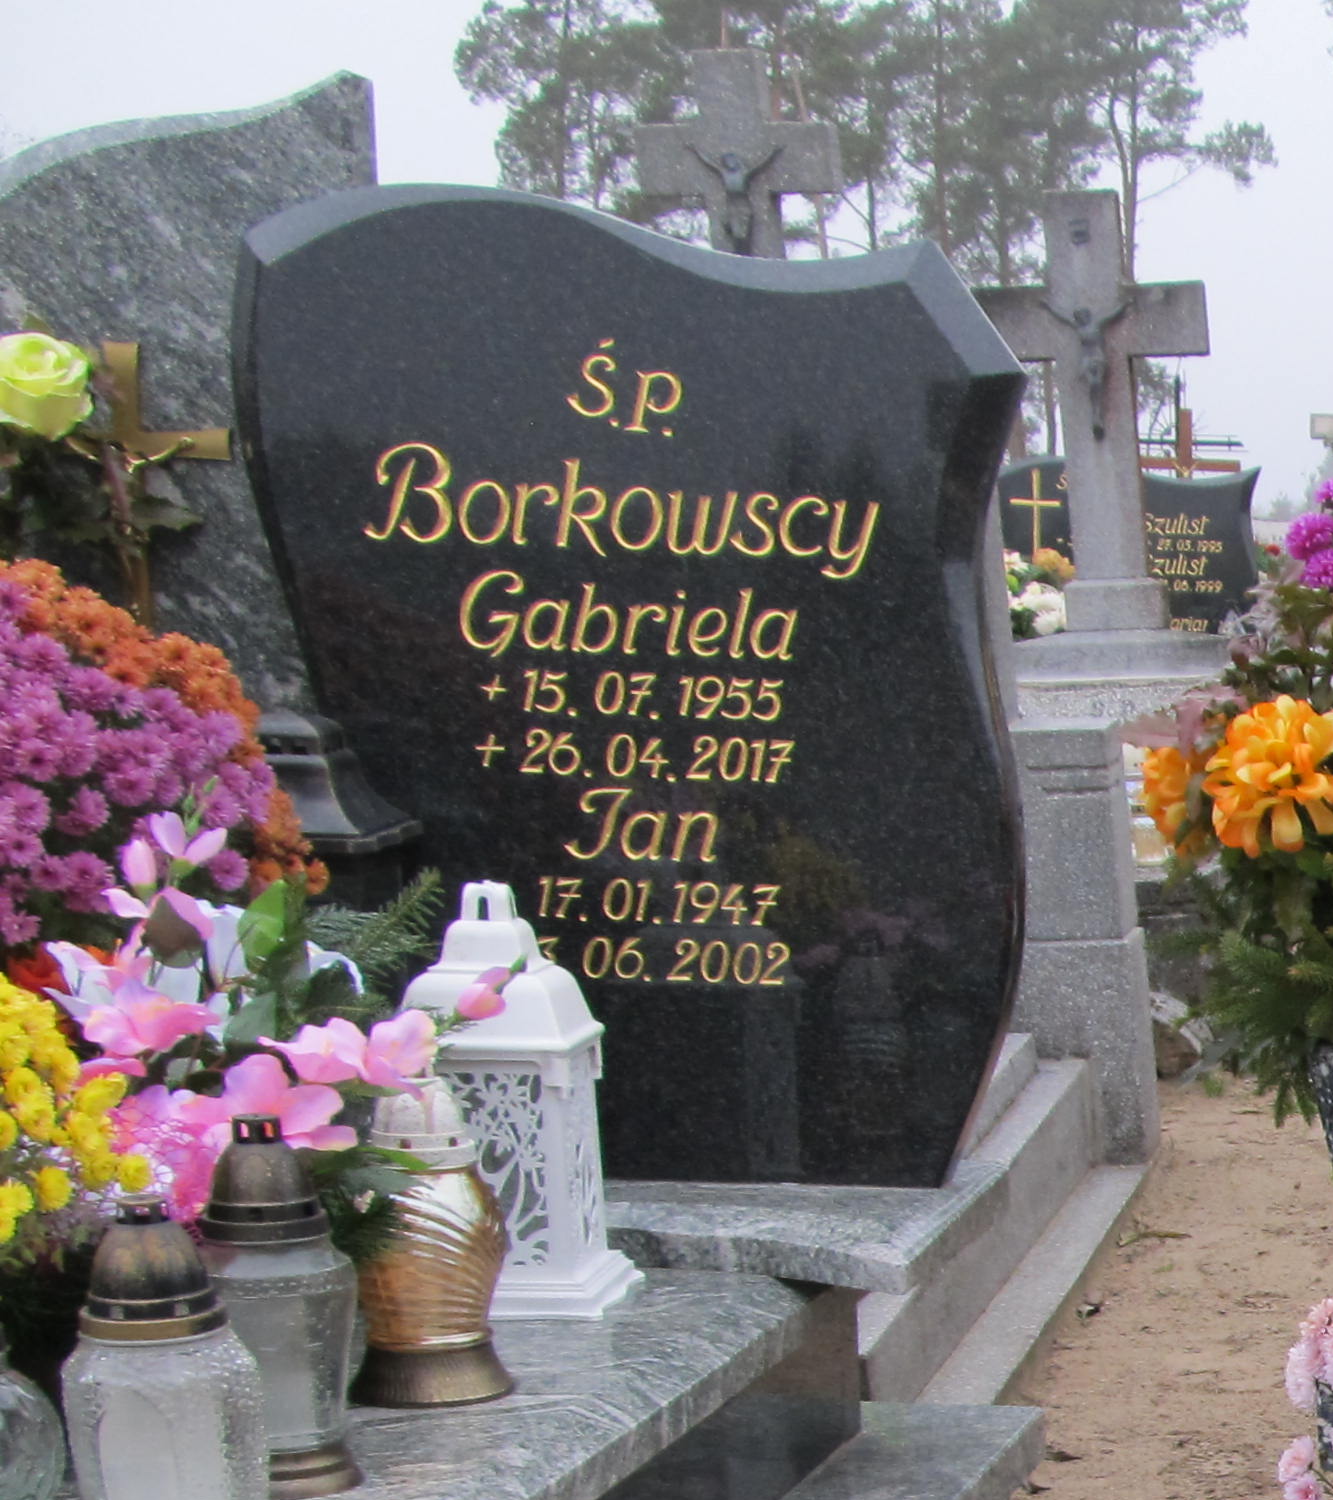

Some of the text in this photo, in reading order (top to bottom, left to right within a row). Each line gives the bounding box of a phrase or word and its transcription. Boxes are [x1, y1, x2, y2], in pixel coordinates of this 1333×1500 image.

[363, 440, 881, 580] Borkowscy
[1148, 553, 1210, 576] zulist
[459, 569, 799, 661] Gabriela
[563, 787, 720, 863] Jan
